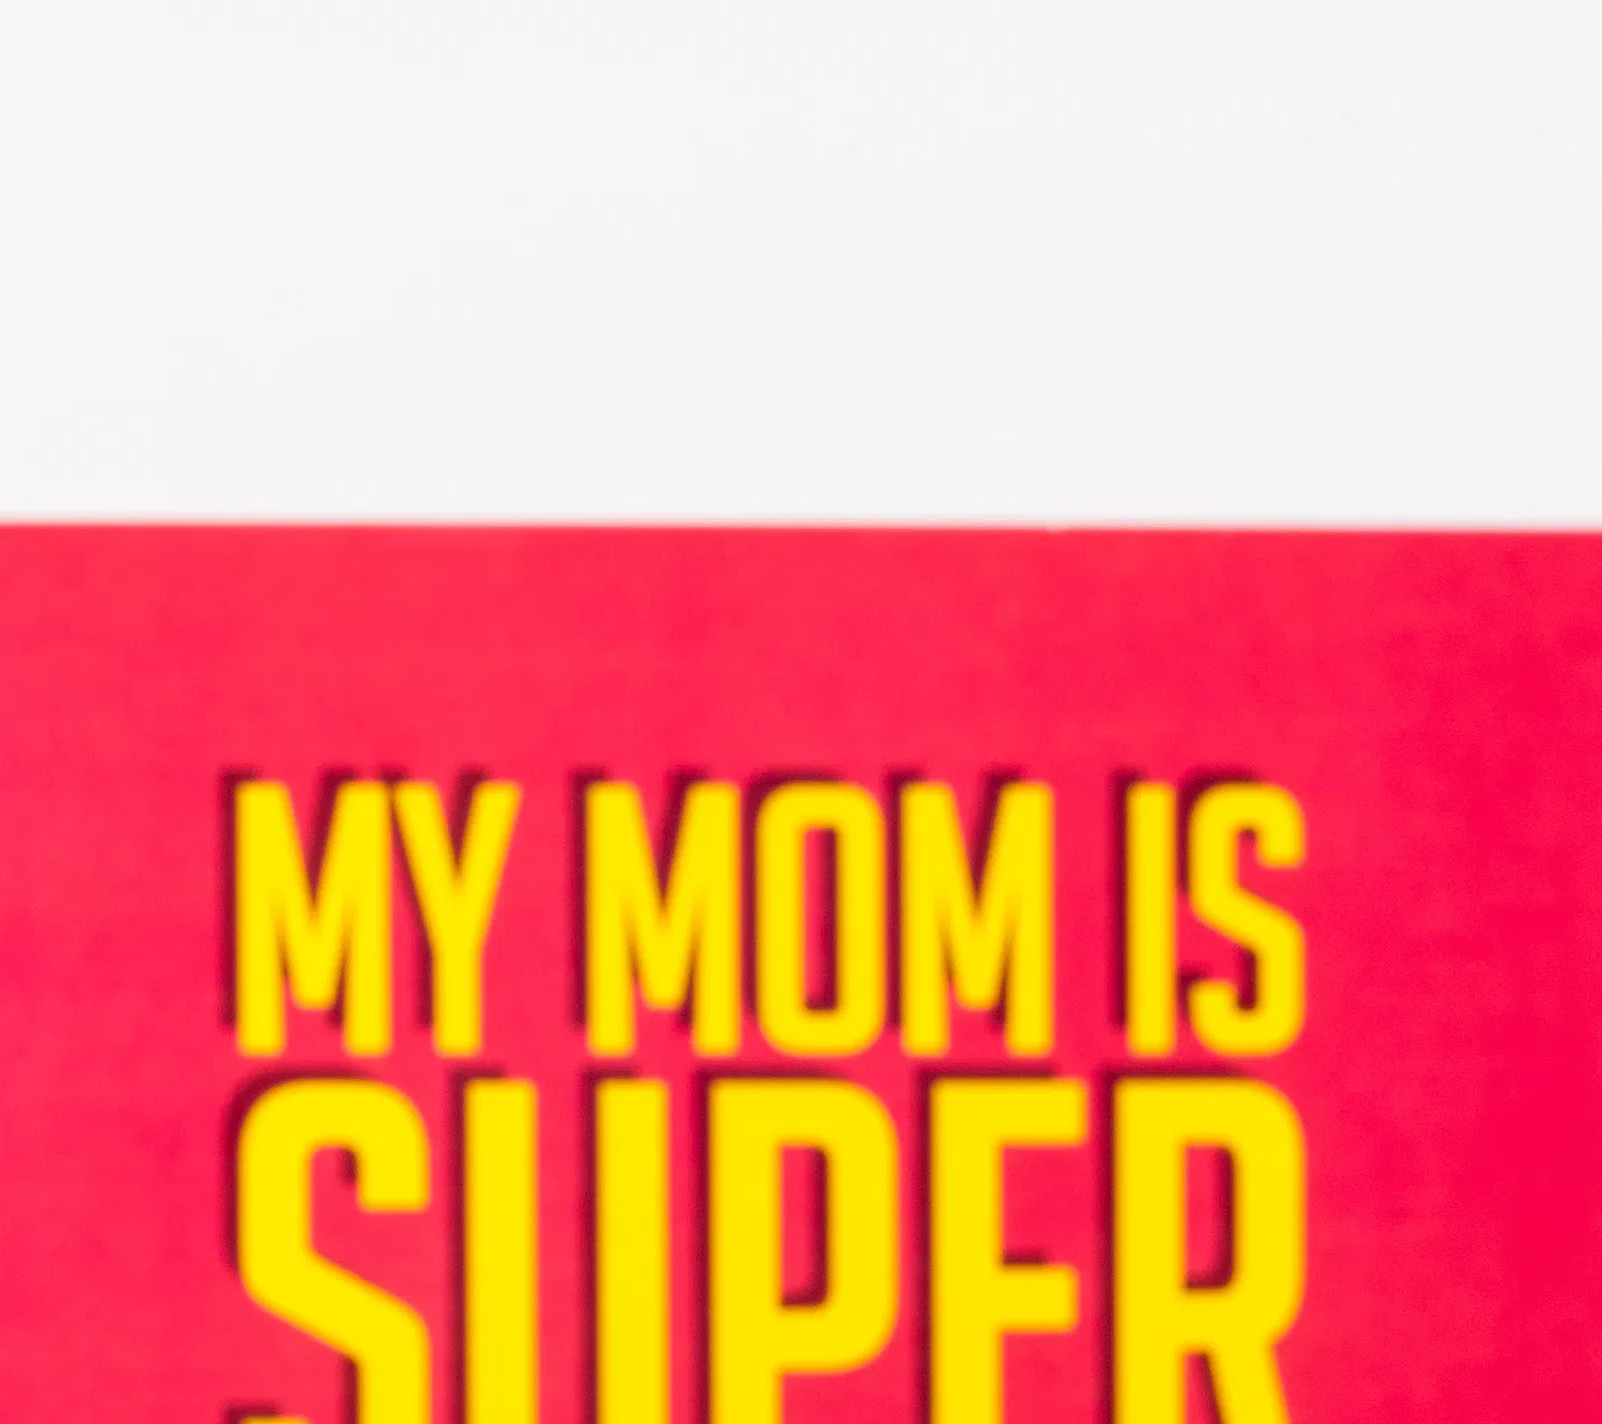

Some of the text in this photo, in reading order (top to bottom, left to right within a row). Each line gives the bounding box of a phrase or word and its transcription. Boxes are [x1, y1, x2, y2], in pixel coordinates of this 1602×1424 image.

[234, 779, 1308, 1059] MY MOM IS
